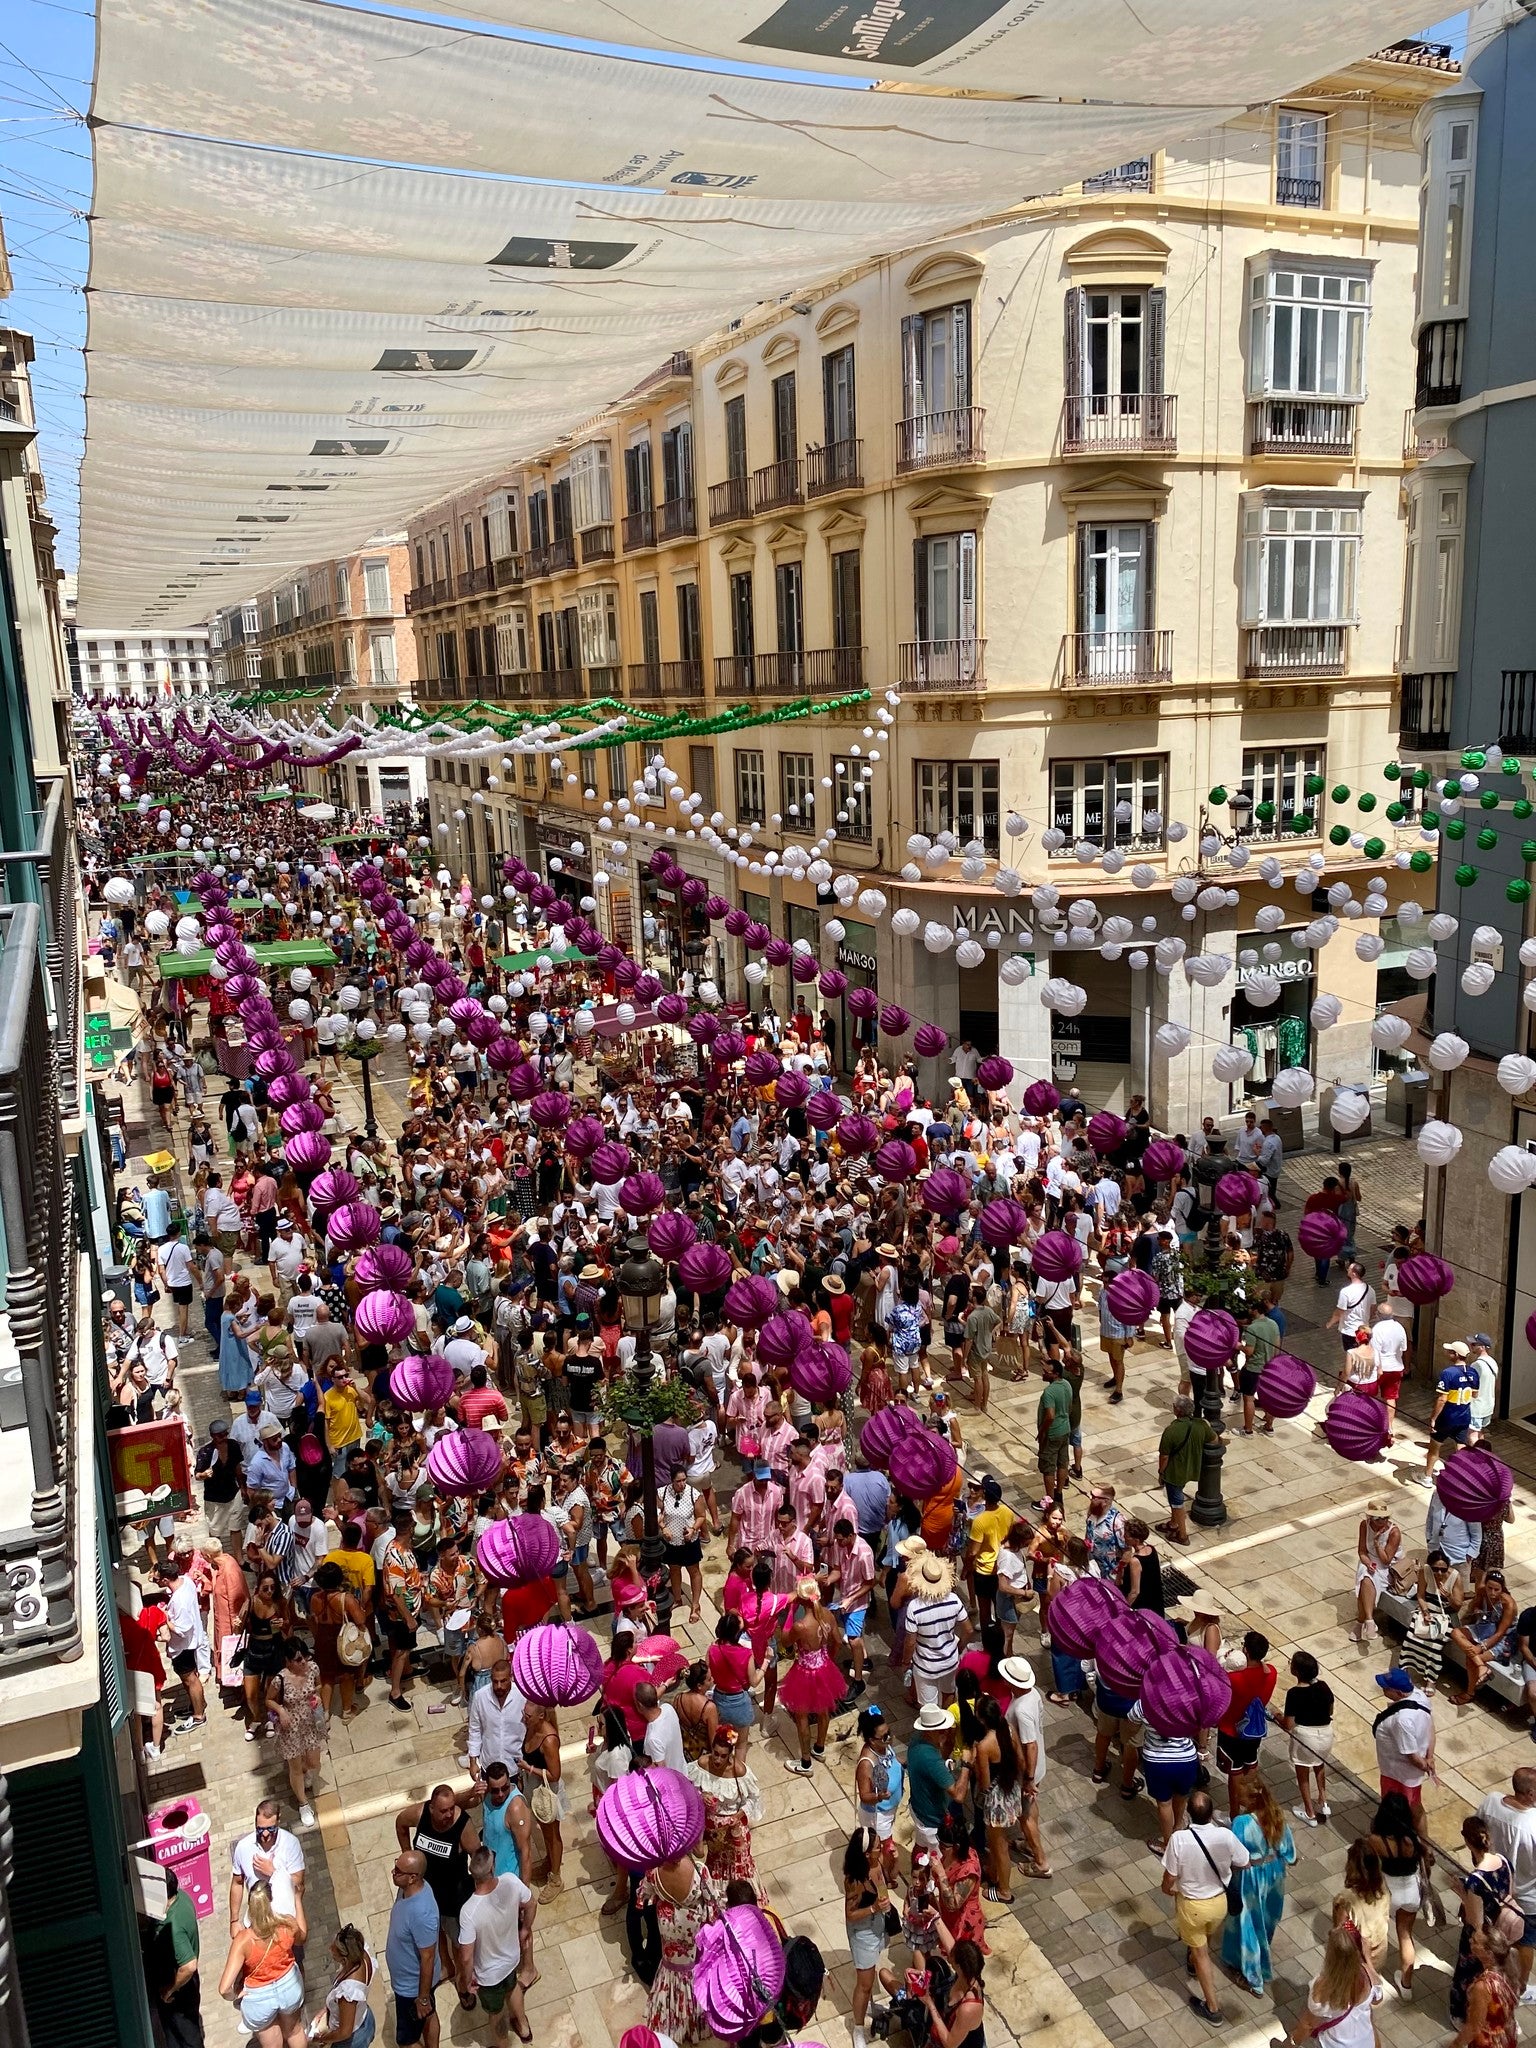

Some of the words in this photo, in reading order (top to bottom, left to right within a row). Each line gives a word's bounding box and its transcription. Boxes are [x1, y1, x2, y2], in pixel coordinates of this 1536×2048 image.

[1056, 813, 1072, 825] ME
[1086, 812, 1101, 824] ME
[839, 947, 876, 971] MANGO
[1058, 1021, 1080, 1034] 24h
[1456, 1386, 1472, 1405] 10
[427, 1841, 448, 1854] PUMA
